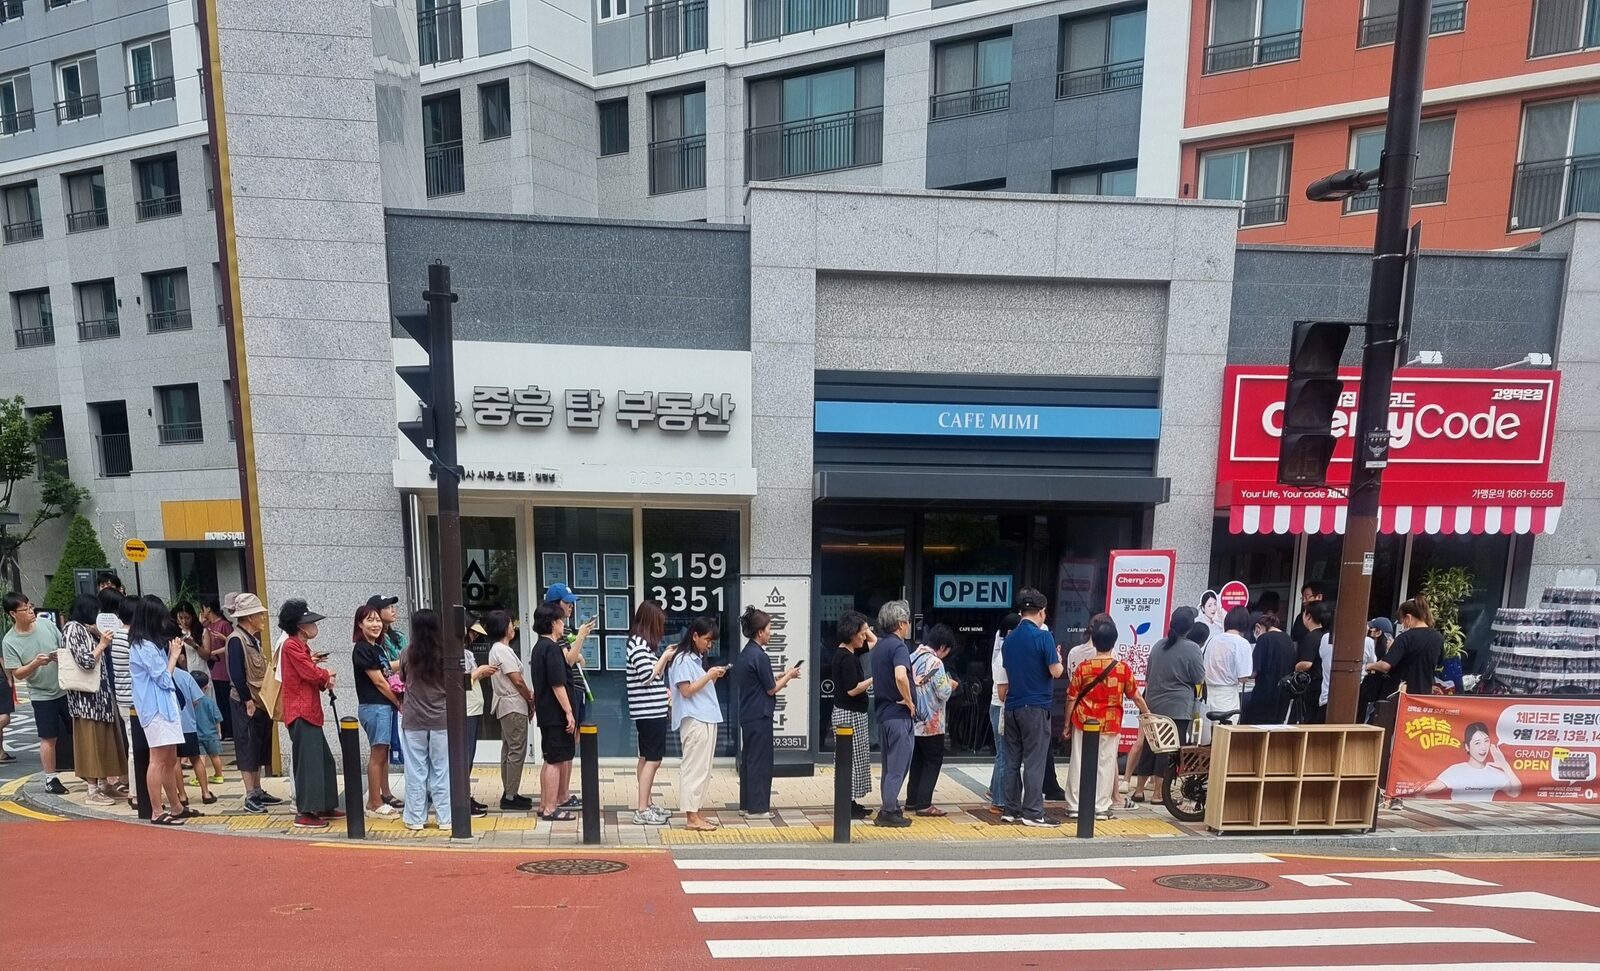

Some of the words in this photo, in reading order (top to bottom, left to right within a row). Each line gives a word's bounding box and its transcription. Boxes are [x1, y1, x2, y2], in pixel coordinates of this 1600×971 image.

[1491, 388, 1544, 401] 고양덕은점
[472, 385, 554, 427] 중흥
[565, 388, 605, 430] 탑
[616, 390, 736, 433] 부동산
[938, 411, 985, 429] CAFE
[990, 413, 1040, 431] MIMI
[1261, 401, 1521, 449] CeyCode
[477, 470, 505, 481] 사무소
[507, 471, 526, 482] 대표
[1241, 490, 1261, 499] Your
[1262, 490, 1281, 499] Life,
[1282, 490, 1302, 499] Your
[1303, 490, 1326, 499] code
[1472, 489, 1505, 499] 가맹문의
[1506, 489, 1554, 499] 1661-6556
[650, 552, 727, 579] 3159
[1117, 576, 1163, 585] CherryCode
[651, 585, 725, 612] 3351
[939, 580, 1008, 603] OPEN
[766, 595, 786, 604] TOP
[1115, 597, 1134, 605] 신개념
[1135, 597, 1161, 605] 오프라인
[1516, 711, 1560, 724] 체리코드
[1563, 712, 1600, 725] 덕은점(
[1405, 716, 1452, 739] 선착순
[1420, 732, 1461, 750] 이래요
[1513, 728, 1533, 741] 9월
[1534, 729, 1560, 742] 12일,
[1563, 730, 1589, 743] 13일,
[1514, 749, 1551, 759] GRAND
[1513, 759, 1550, 771] OPEN
